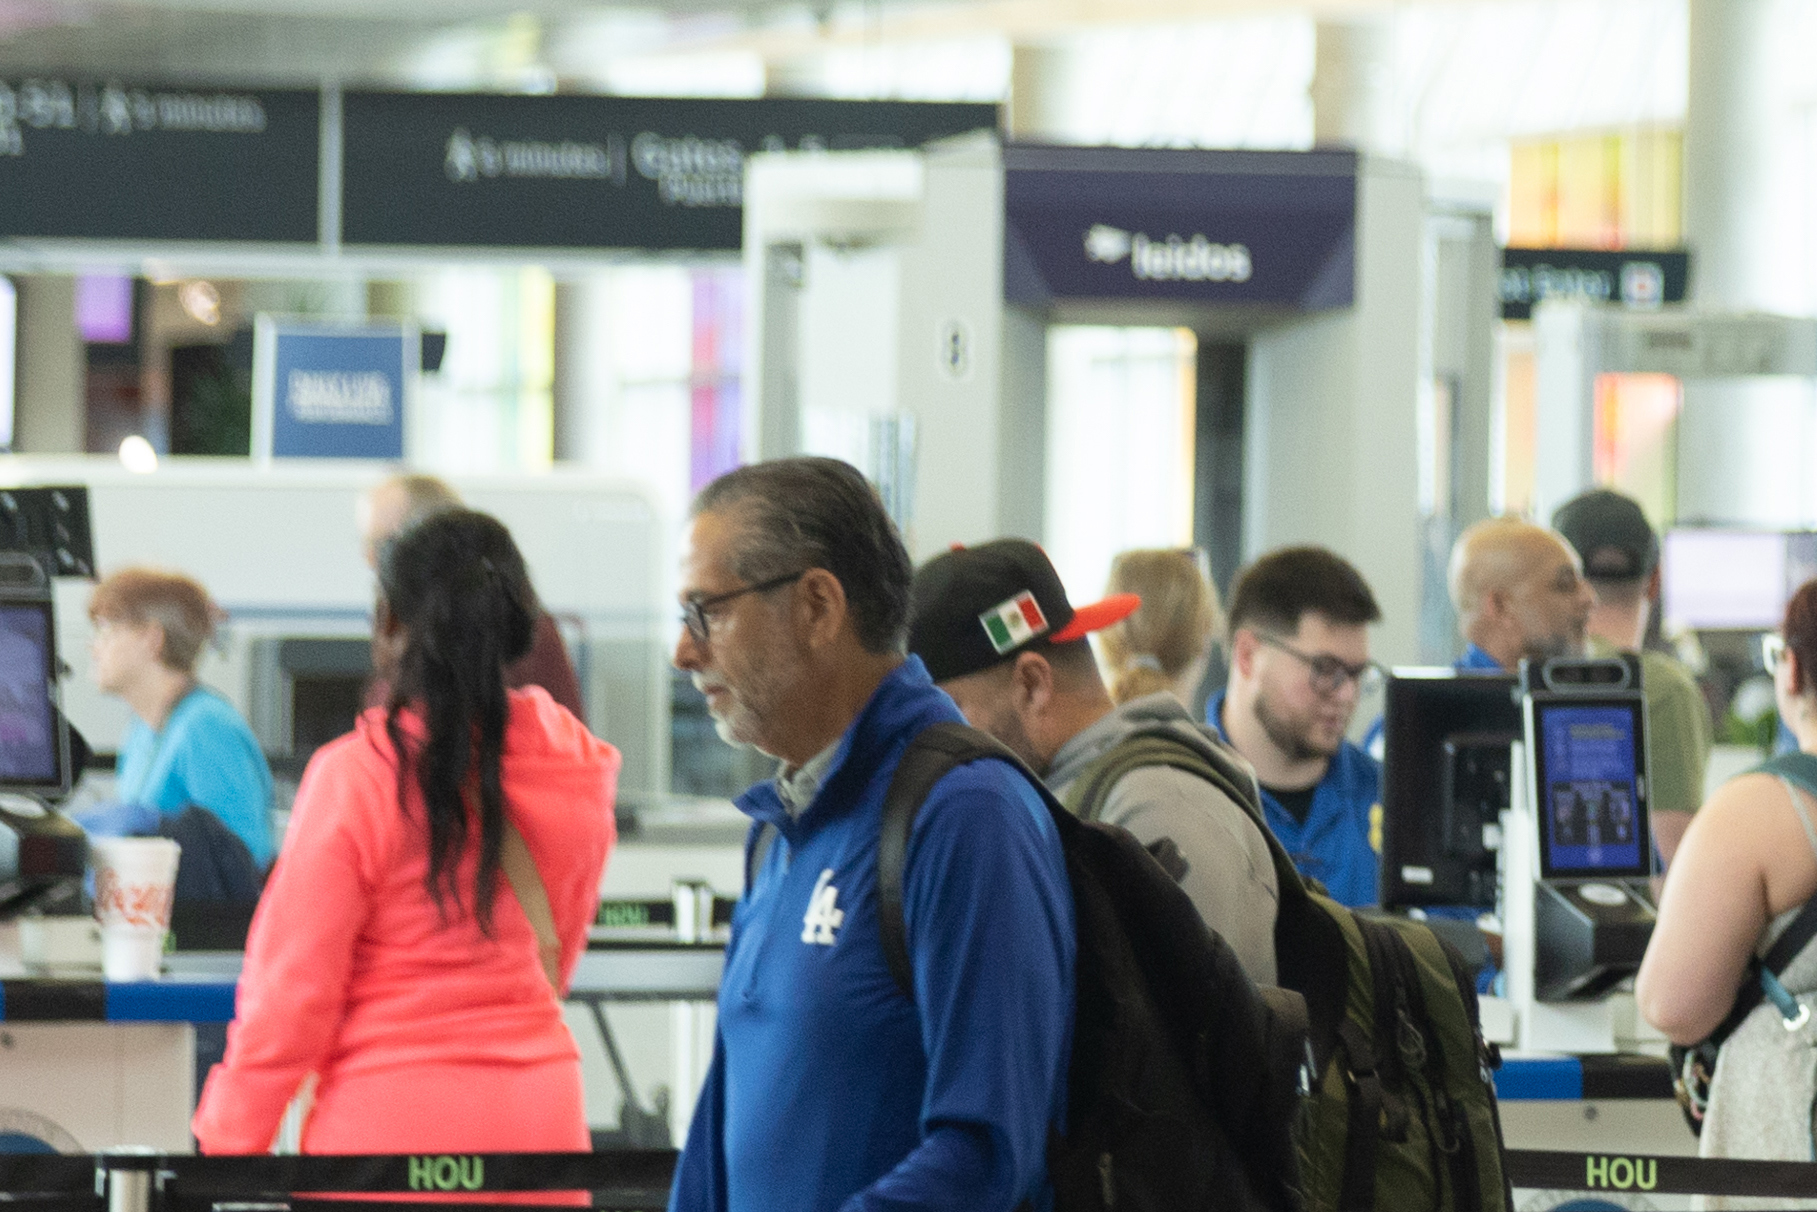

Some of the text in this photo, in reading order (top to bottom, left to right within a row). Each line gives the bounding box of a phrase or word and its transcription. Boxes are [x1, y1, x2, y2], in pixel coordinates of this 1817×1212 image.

[1132, 232, 1252, 283] leidos
[801, 868, 845, 946] LA
[409, 1156, 484, 1190] HOU
[1587, 1156, 1657, 1190] HOU
